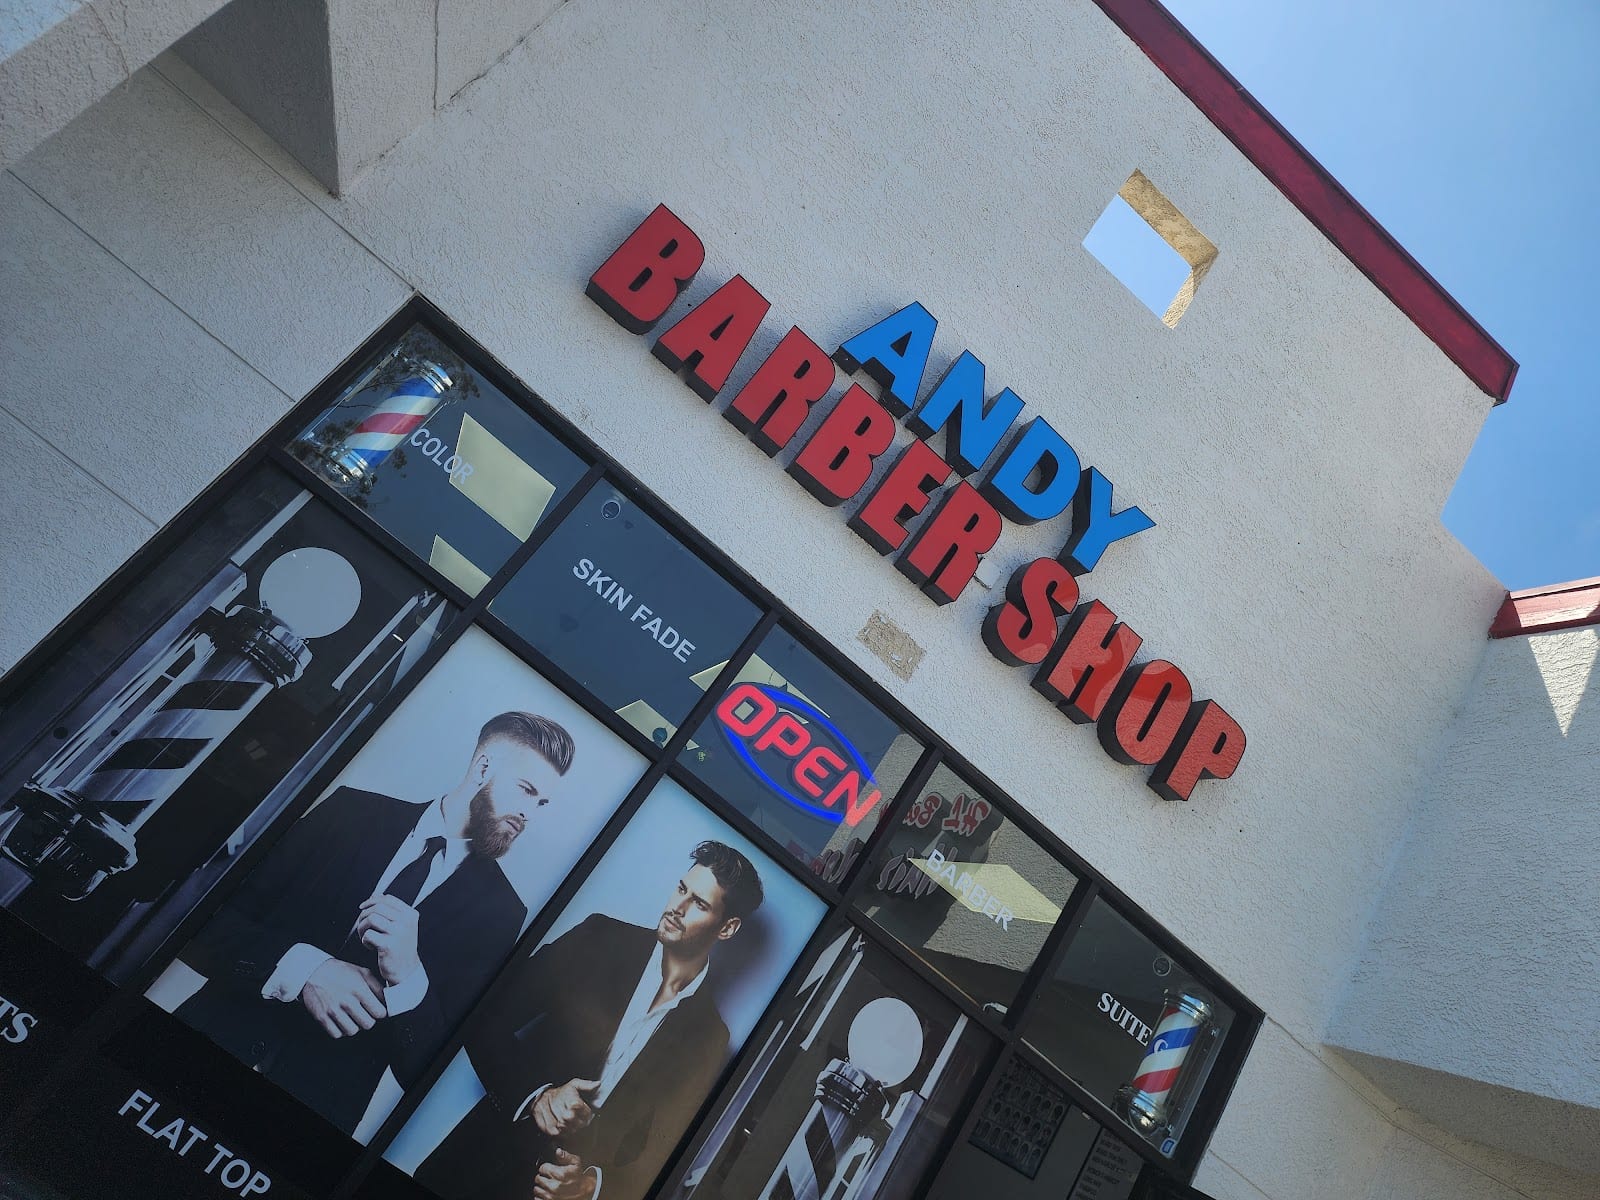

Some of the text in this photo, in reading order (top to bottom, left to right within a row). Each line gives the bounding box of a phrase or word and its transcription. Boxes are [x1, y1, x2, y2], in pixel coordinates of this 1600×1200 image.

[410, 428, 475, 486] COLOR
[836, 301, 1156, 573] ANDY
[588, 203, 1247, 801] BARBER SHOP
[572, 558, 697, 664] SKIN FADE
[716, 684, 882, 827] OPEN
[925, 848, 1014, 932] BARBER
[1096, 992, 1153, 1047] SUITE
[118, 1088, 272, 1199] FLAT TOP
